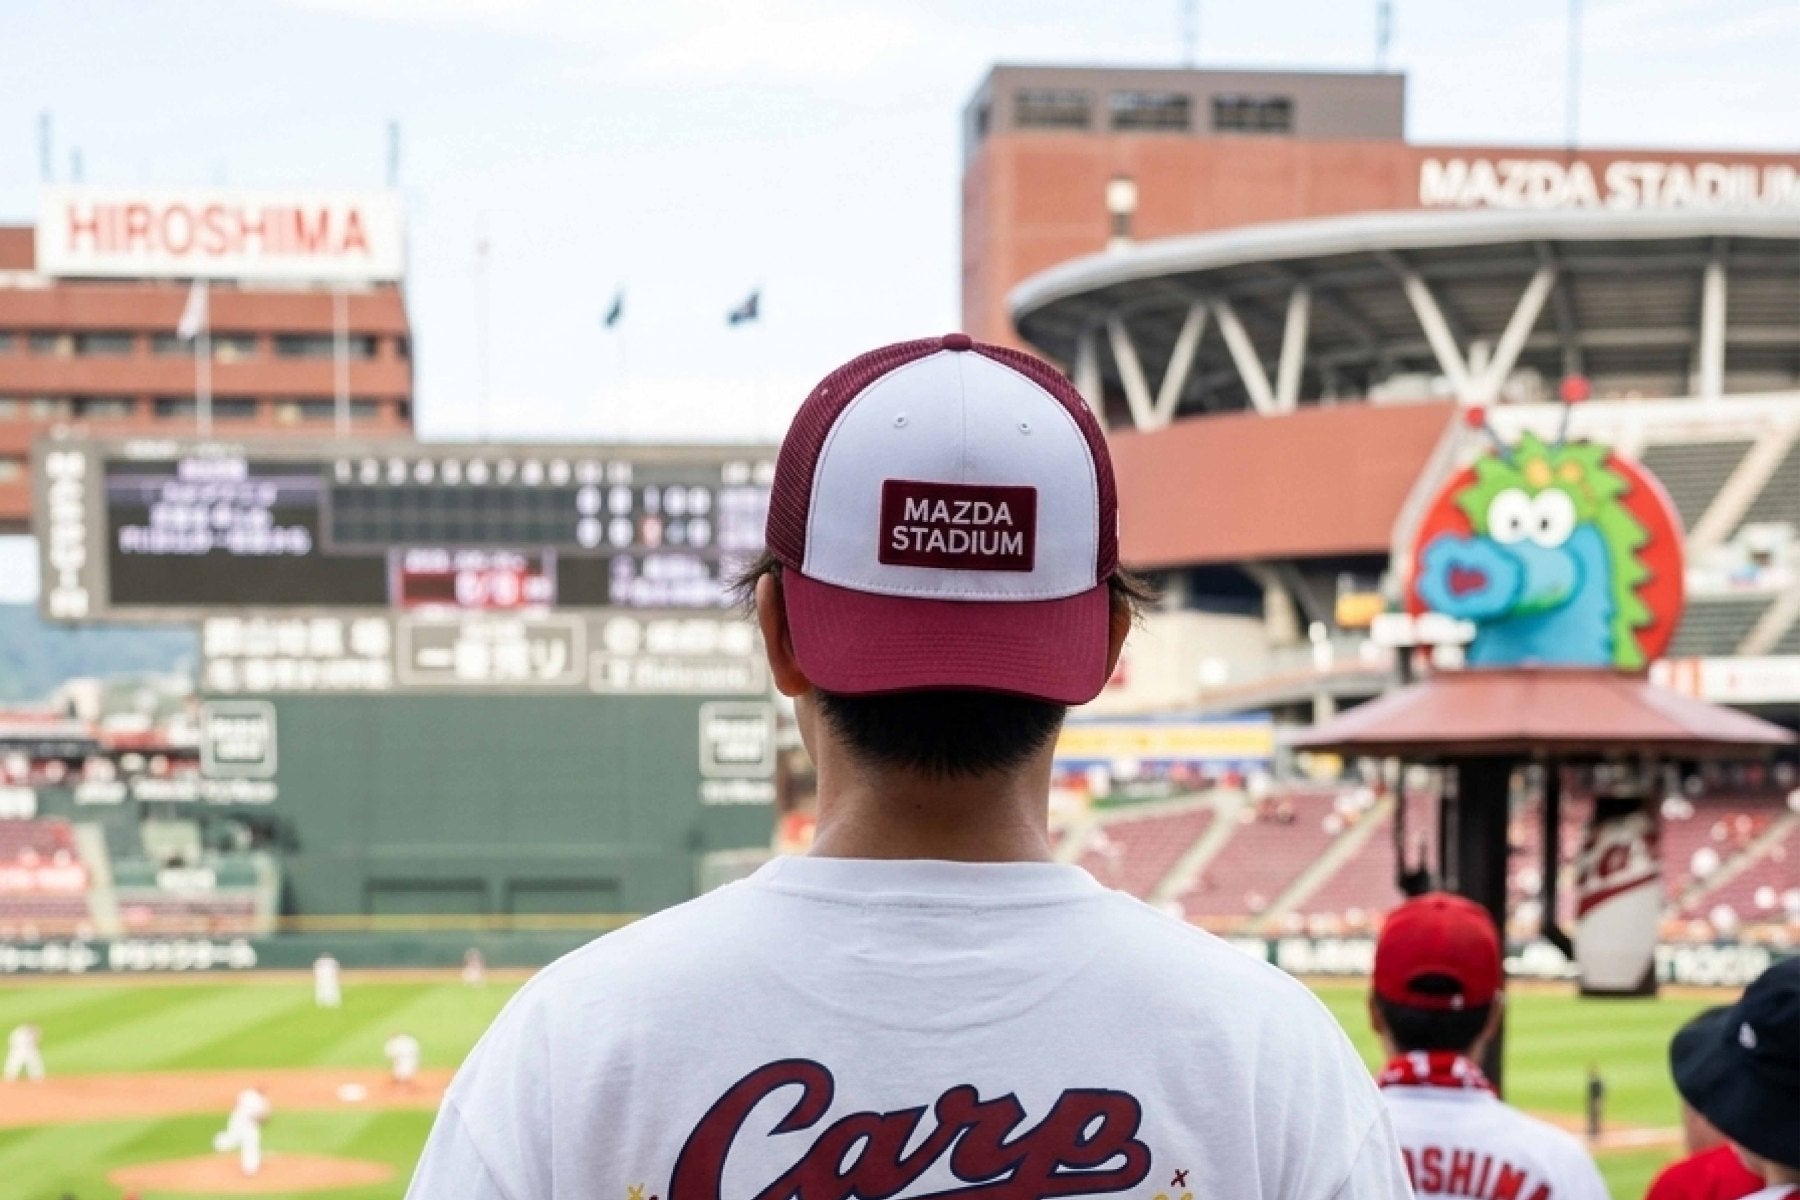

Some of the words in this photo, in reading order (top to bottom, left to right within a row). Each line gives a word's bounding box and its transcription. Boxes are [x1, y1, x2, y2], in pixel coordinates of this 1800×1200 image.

[1419, 158, 1602, 208] MAZDA
[1604, 161, 1800, 212] STADIUM
[66, 204, 371, 256] HIROSHIMA
[903, 498, 1013, 526] MAZDA
[891, 525, 1023, 556] STADIUM
